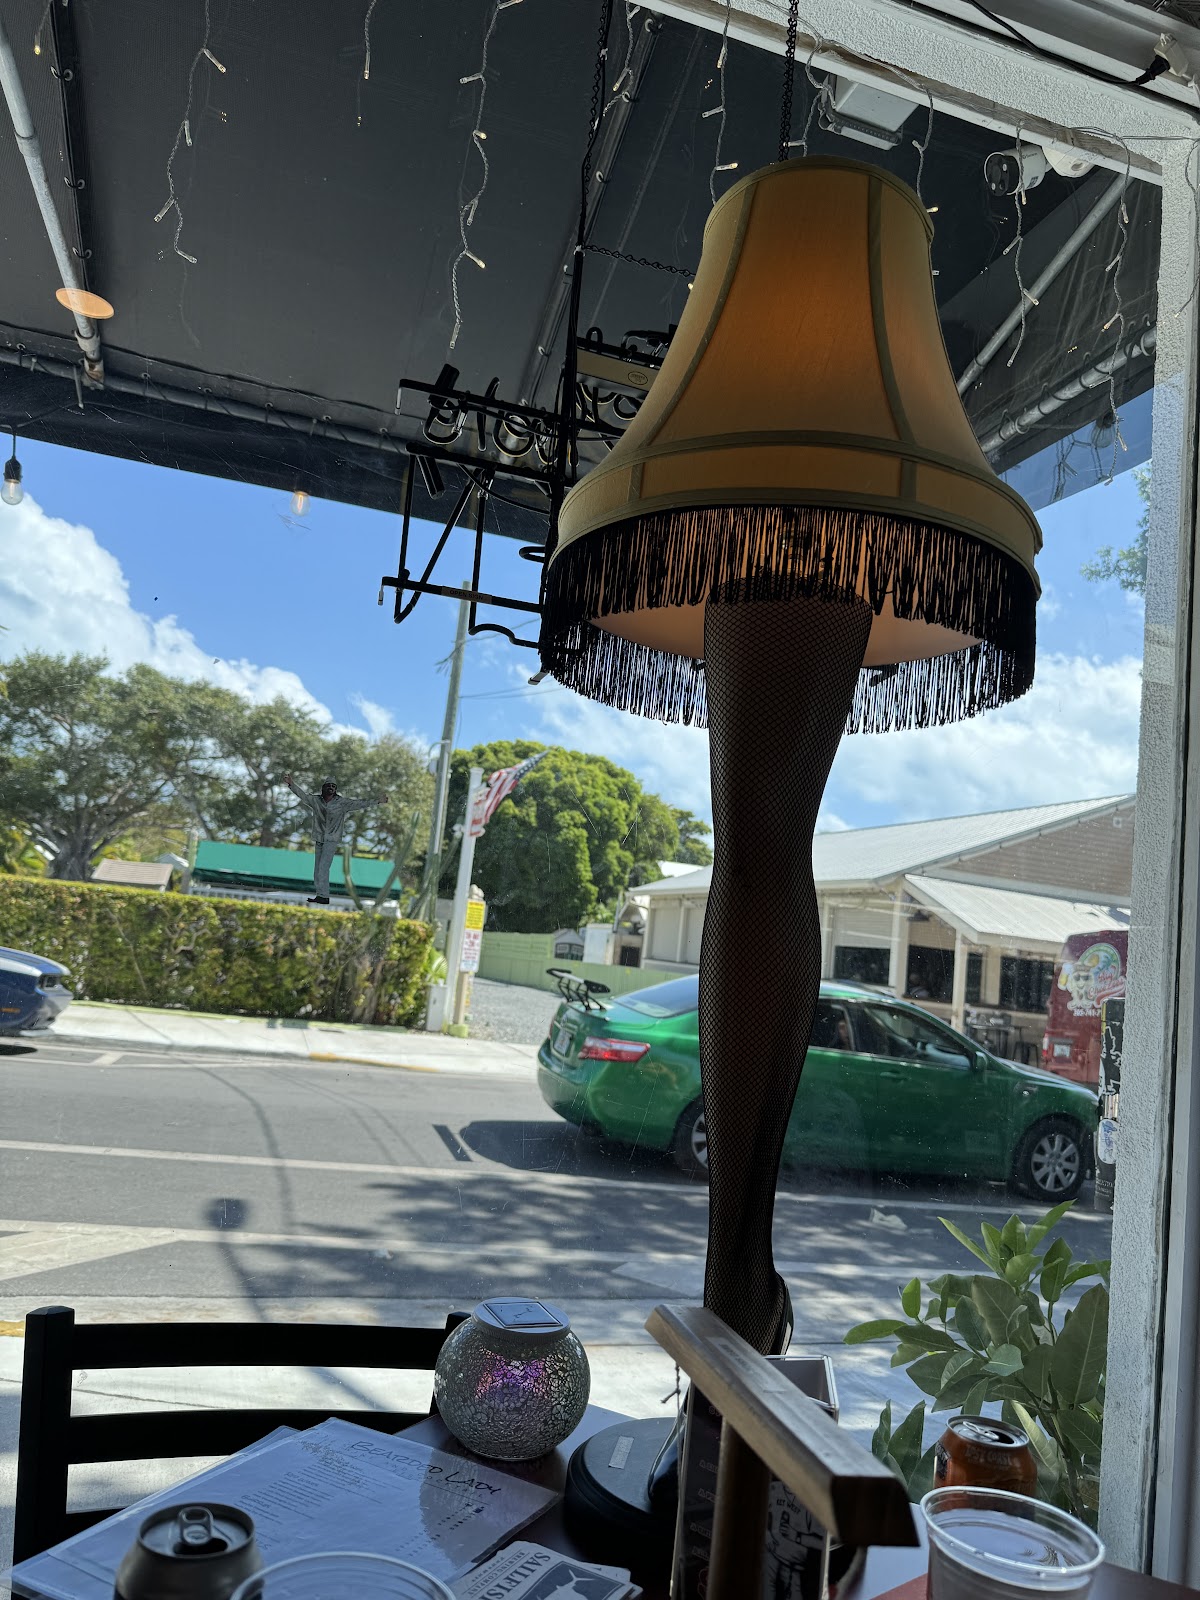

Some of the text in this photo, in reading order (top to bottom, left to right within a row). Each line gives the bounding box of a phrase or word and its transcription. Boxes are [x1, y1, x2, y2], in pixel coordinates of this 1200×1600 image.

[449, 589, 484, 600] OPEN SIGN
[350, 1441, 443, 1475] BEARDED
[445, 1471, 501, 1496] LADY
[787, 1502, 802, 1514] WEST
[496, 1551, 526, 1573] BREWING
[468, 1572, 498, 1595] COMPANY
